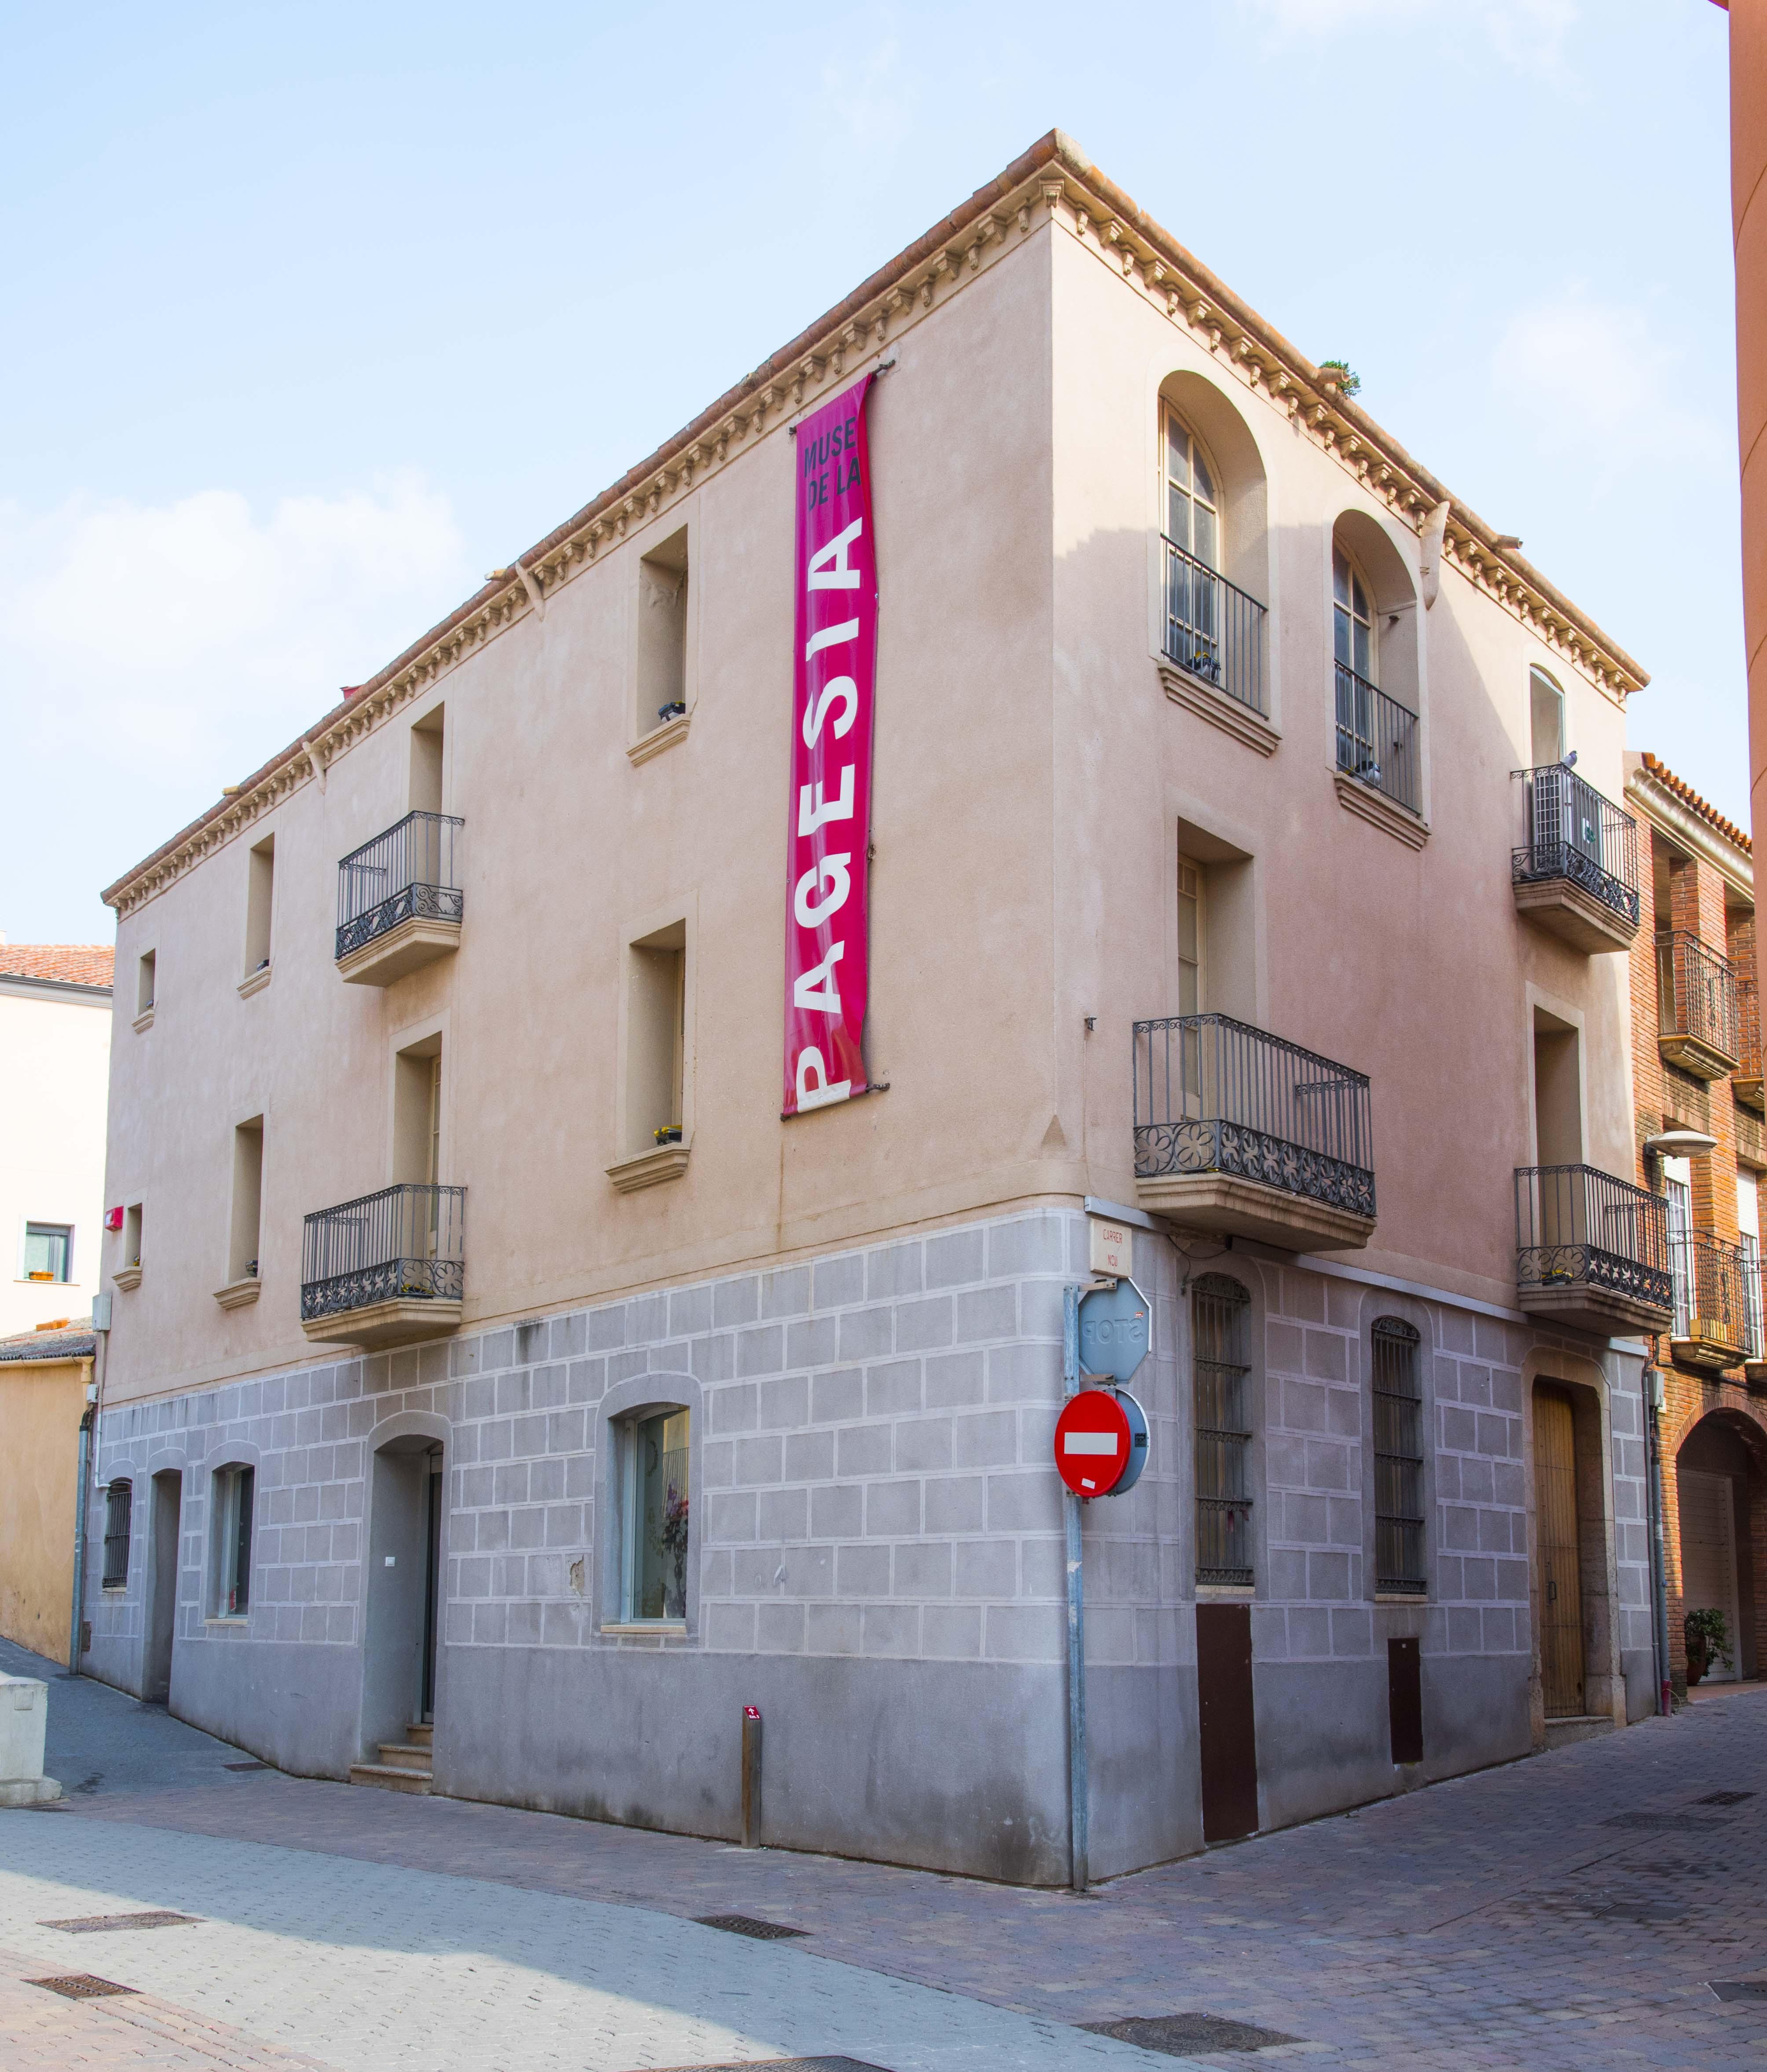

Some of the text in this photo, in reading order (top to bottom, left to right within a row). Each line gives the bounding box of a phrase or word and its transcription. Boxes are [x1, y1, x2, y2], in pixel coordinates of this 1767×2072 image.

[809, 457, 861, 512] DE LA
[794, 517, 862, 1113] PAGESIA
[1103, 1229, 1122, 1244] CARRER
[1107, 1254, 1118, 1267] NOU
